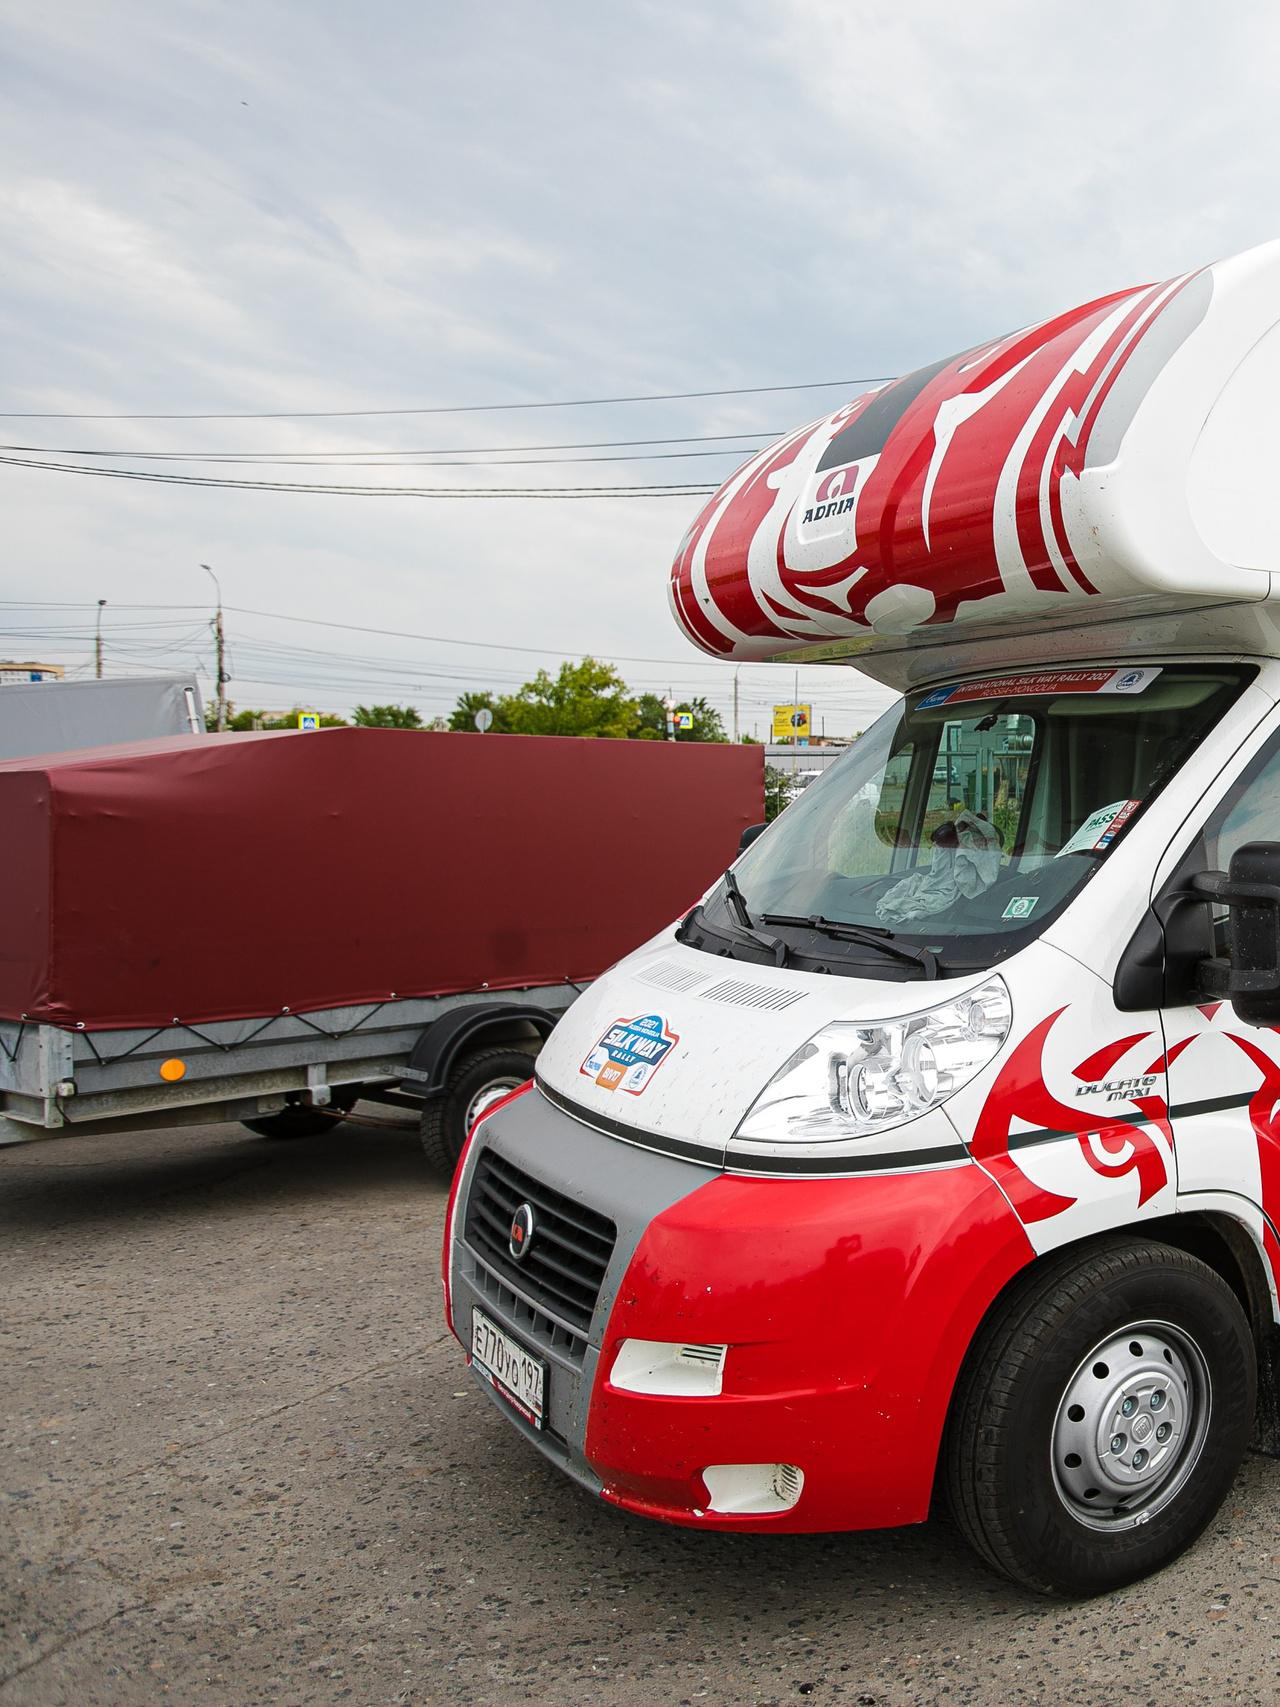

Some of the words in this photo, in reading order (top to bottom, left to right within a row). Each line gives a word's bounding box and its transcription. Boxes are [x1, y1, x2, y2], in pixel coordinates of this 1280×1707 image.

[802, 497, 854, 524] ADRIA
[957, 678, 1015, 693] INTERNATIONAL
[1016, 676, 1034, 686] SILK
[1036, 674, 1058, 684] WAY
[1057, 672, 1086, 683] RALLY
[1087, 671, 1112, 681] 2021
[1085, 812, 1117, 830] PASS
[640, 1018, 660, 1029] 2021
[602, 1029, 639, 1051] SILK
[631, 1036, 668, 1060] WAY
[611, 1050, 636, 1063] RALLY
[1075, 1075, 1157, 1096] DUCATO
[1106, 1088, 1150, 1102] MAXI
[522, 1357, 540, 1394] 197
